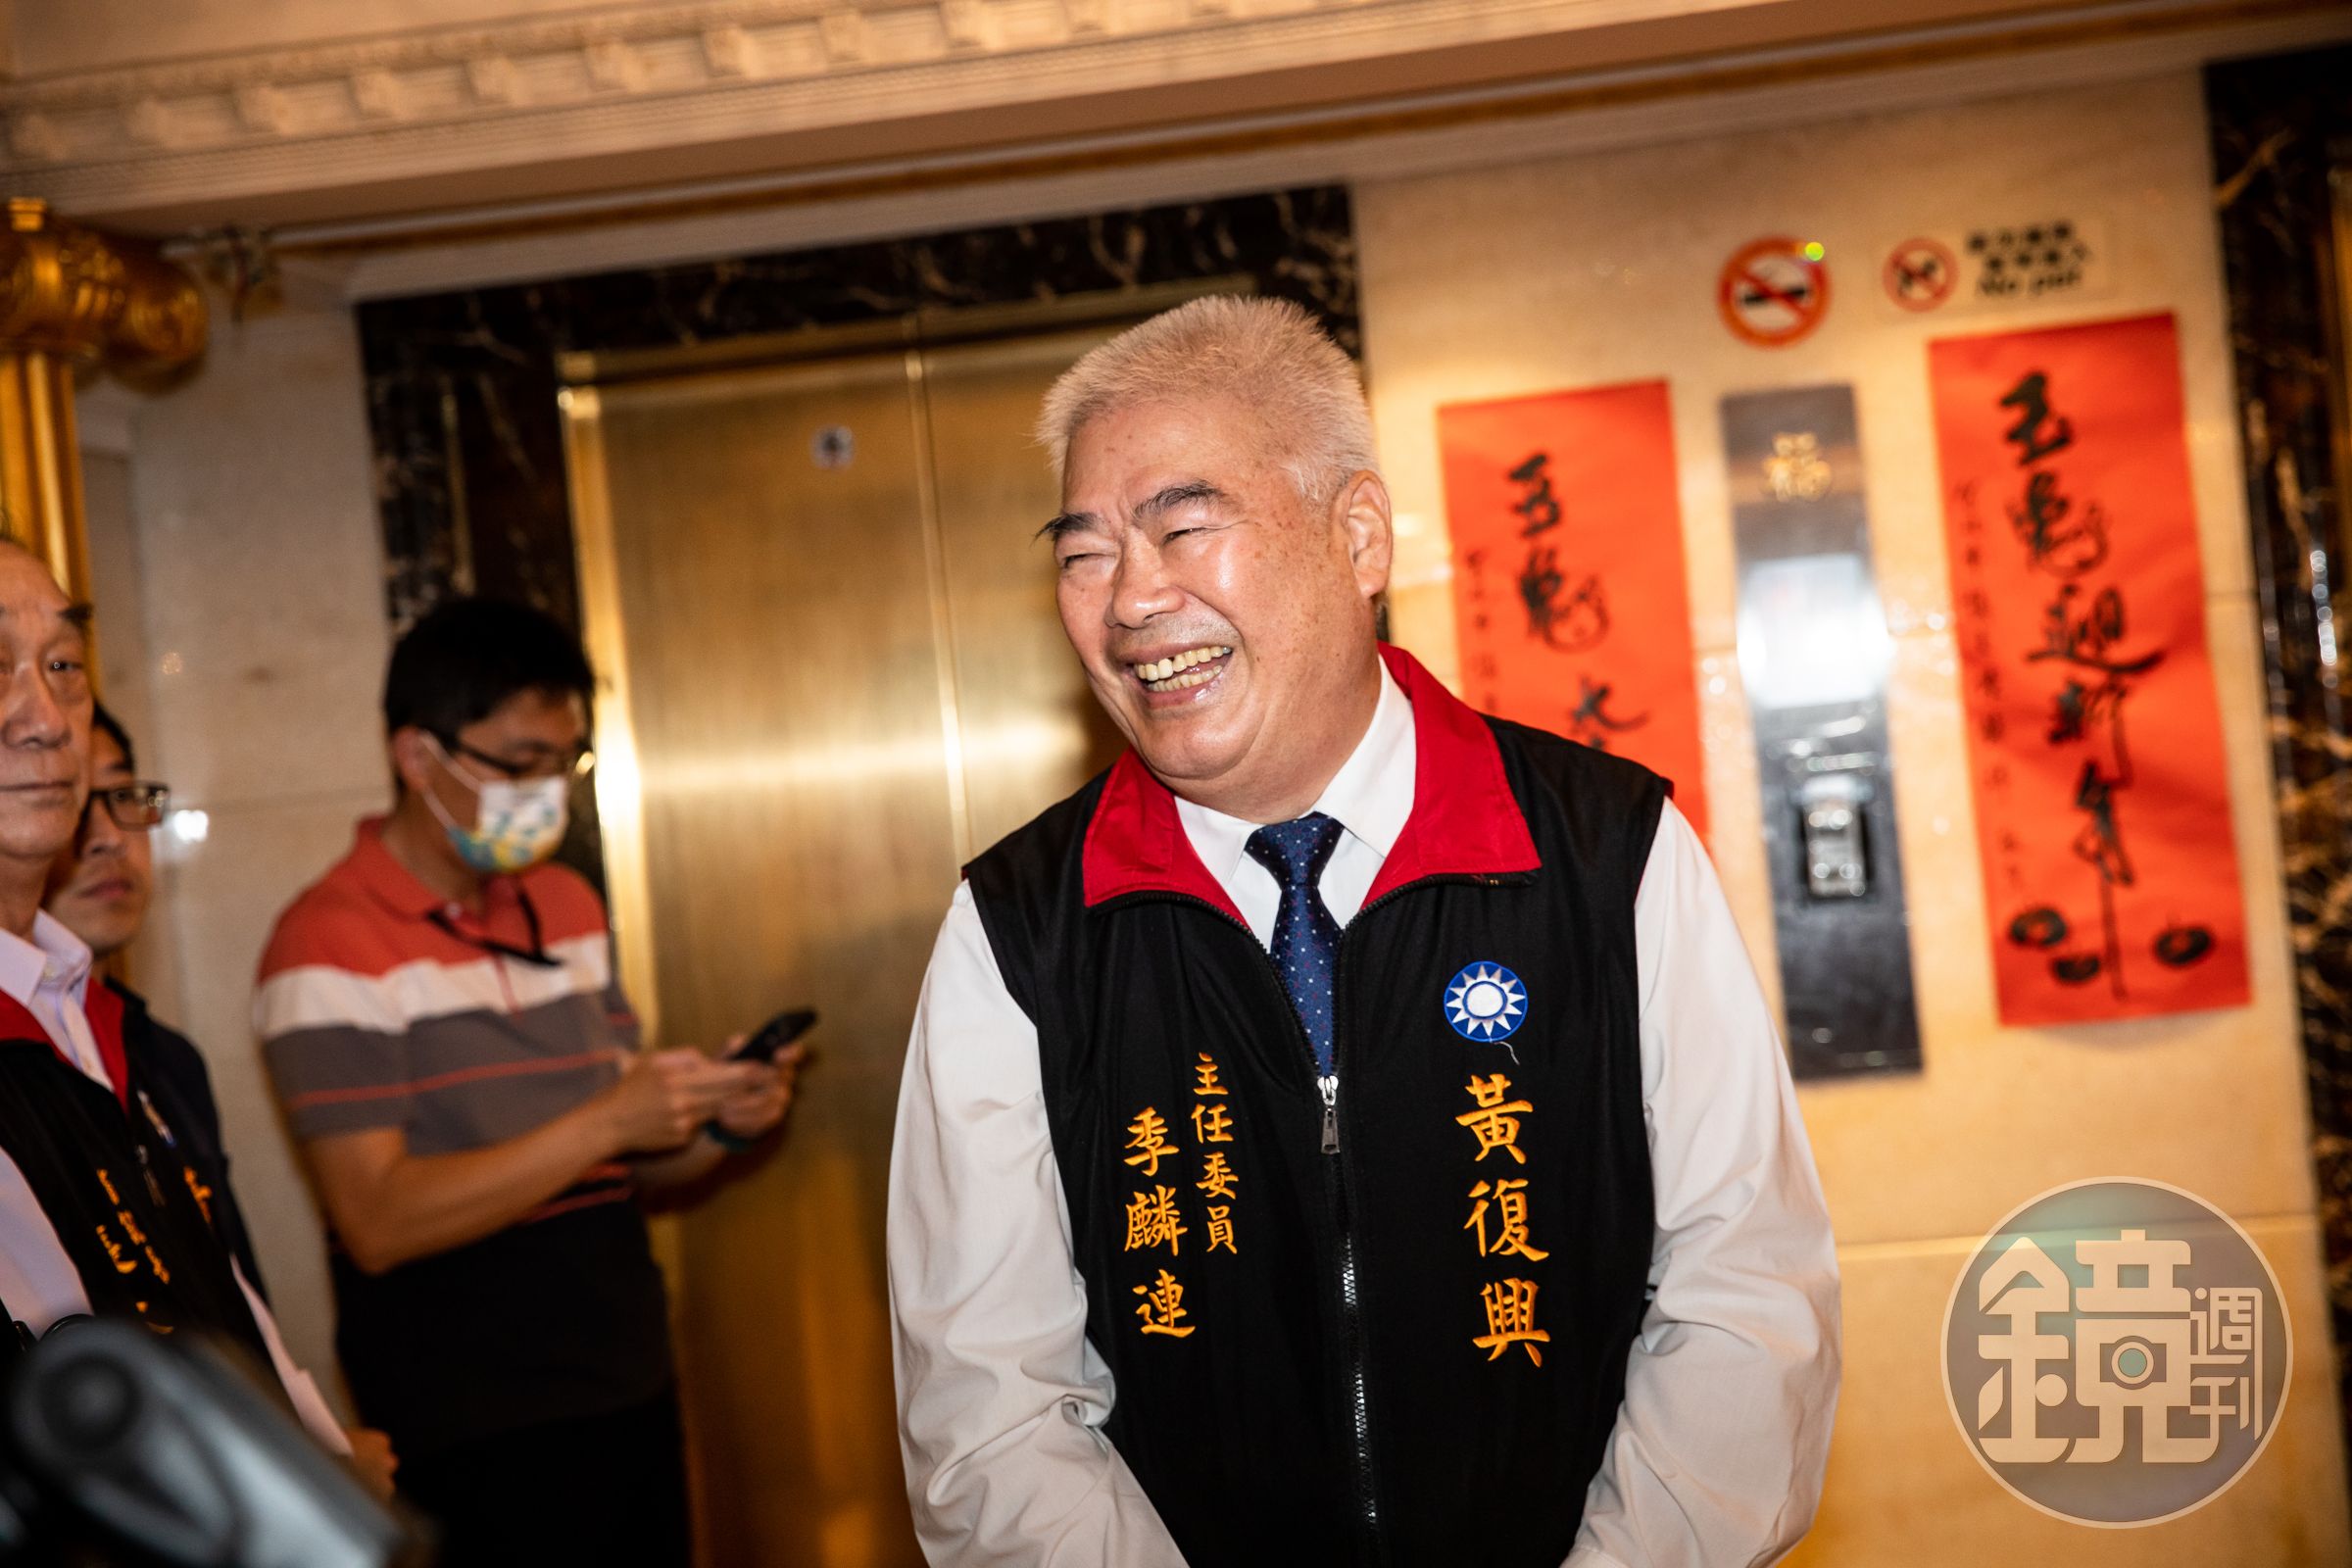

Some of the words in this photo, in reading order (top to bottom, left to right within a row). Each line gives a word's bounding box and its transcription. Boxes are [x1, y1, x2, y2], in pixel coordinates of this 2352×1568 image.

[1123, 1106, 1197, 1339] 季麟連
[1190, 1052, 1240, 1255] 主任委員
[1455, 1073, 1551, 1368] 黃復興
